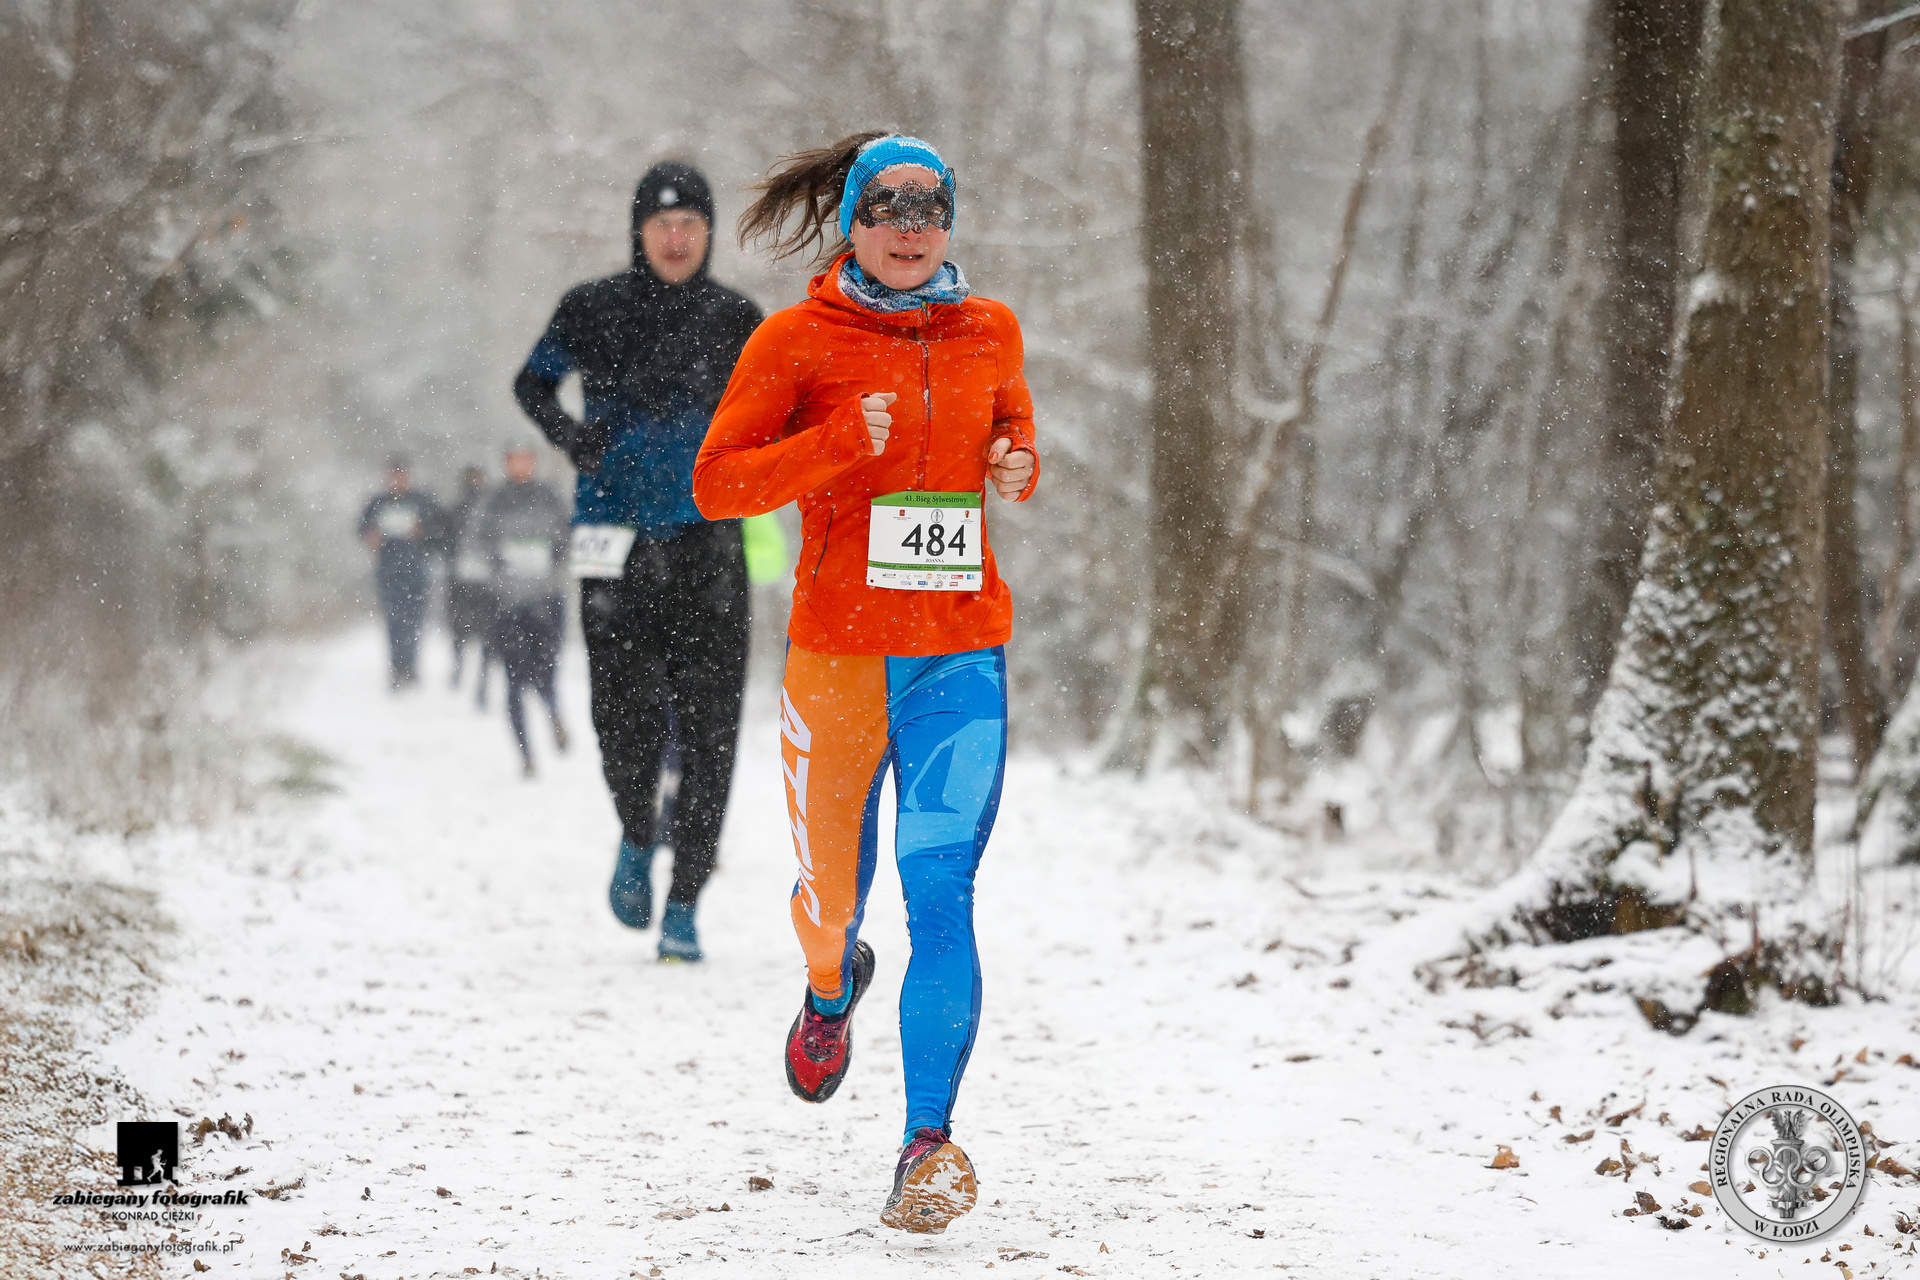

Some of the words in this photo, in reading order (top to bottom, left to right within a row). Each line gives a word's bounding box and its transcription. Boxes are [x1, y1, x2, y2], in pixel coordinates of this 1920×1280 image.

[916, 495, 931, 504] Bieg
[932, 495, 968, 504] Sylwestrowy
[901, 523, 966, 556] 484
